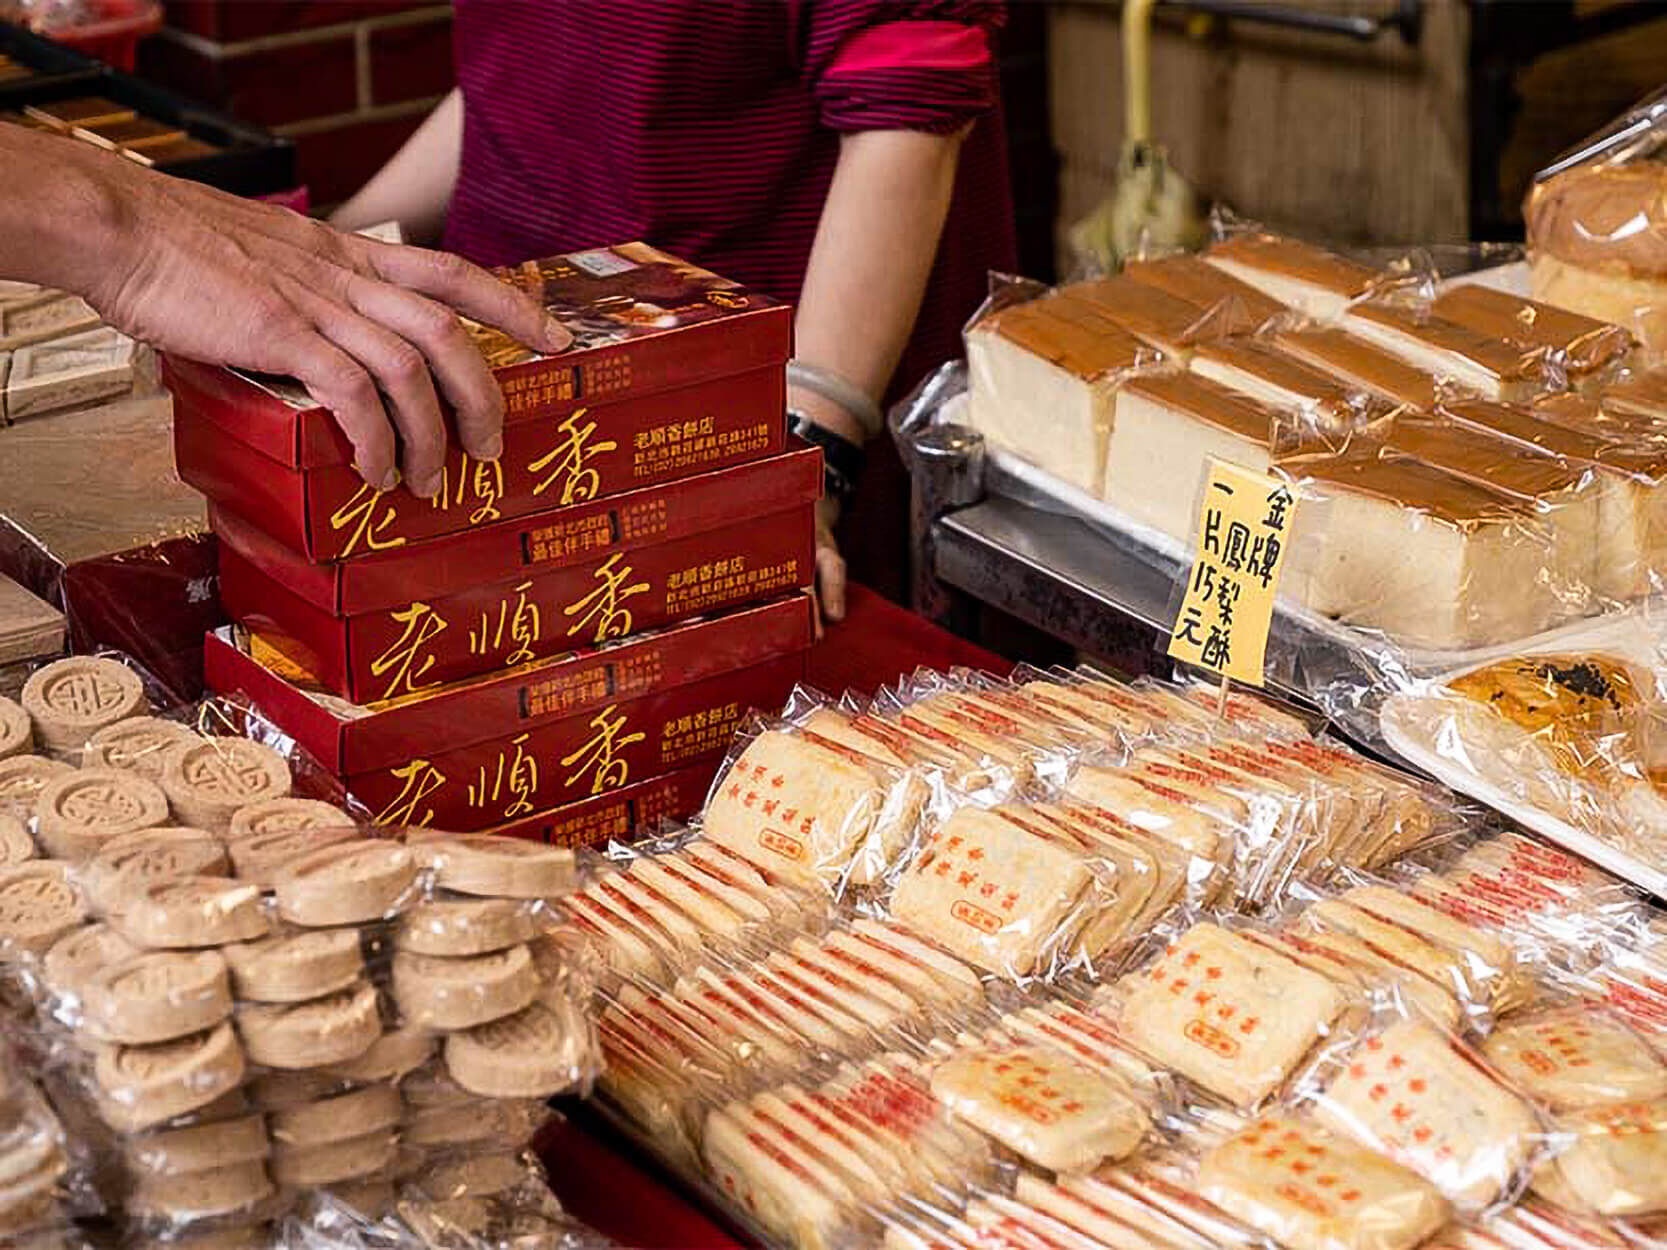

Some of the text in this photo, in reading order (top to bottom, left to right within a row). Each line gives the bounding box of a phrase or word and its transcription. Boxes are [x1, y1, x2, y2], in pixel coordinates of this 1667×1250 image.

[1175, 482, 1233, 646] 一片15元
[1201, 521, 1250, 670] 鳳梨酥
[1246, 485, 1294, 588] 金牌
[371, 552, 650, 697] 老順香
[373, 706, 646, 828] 老順香
